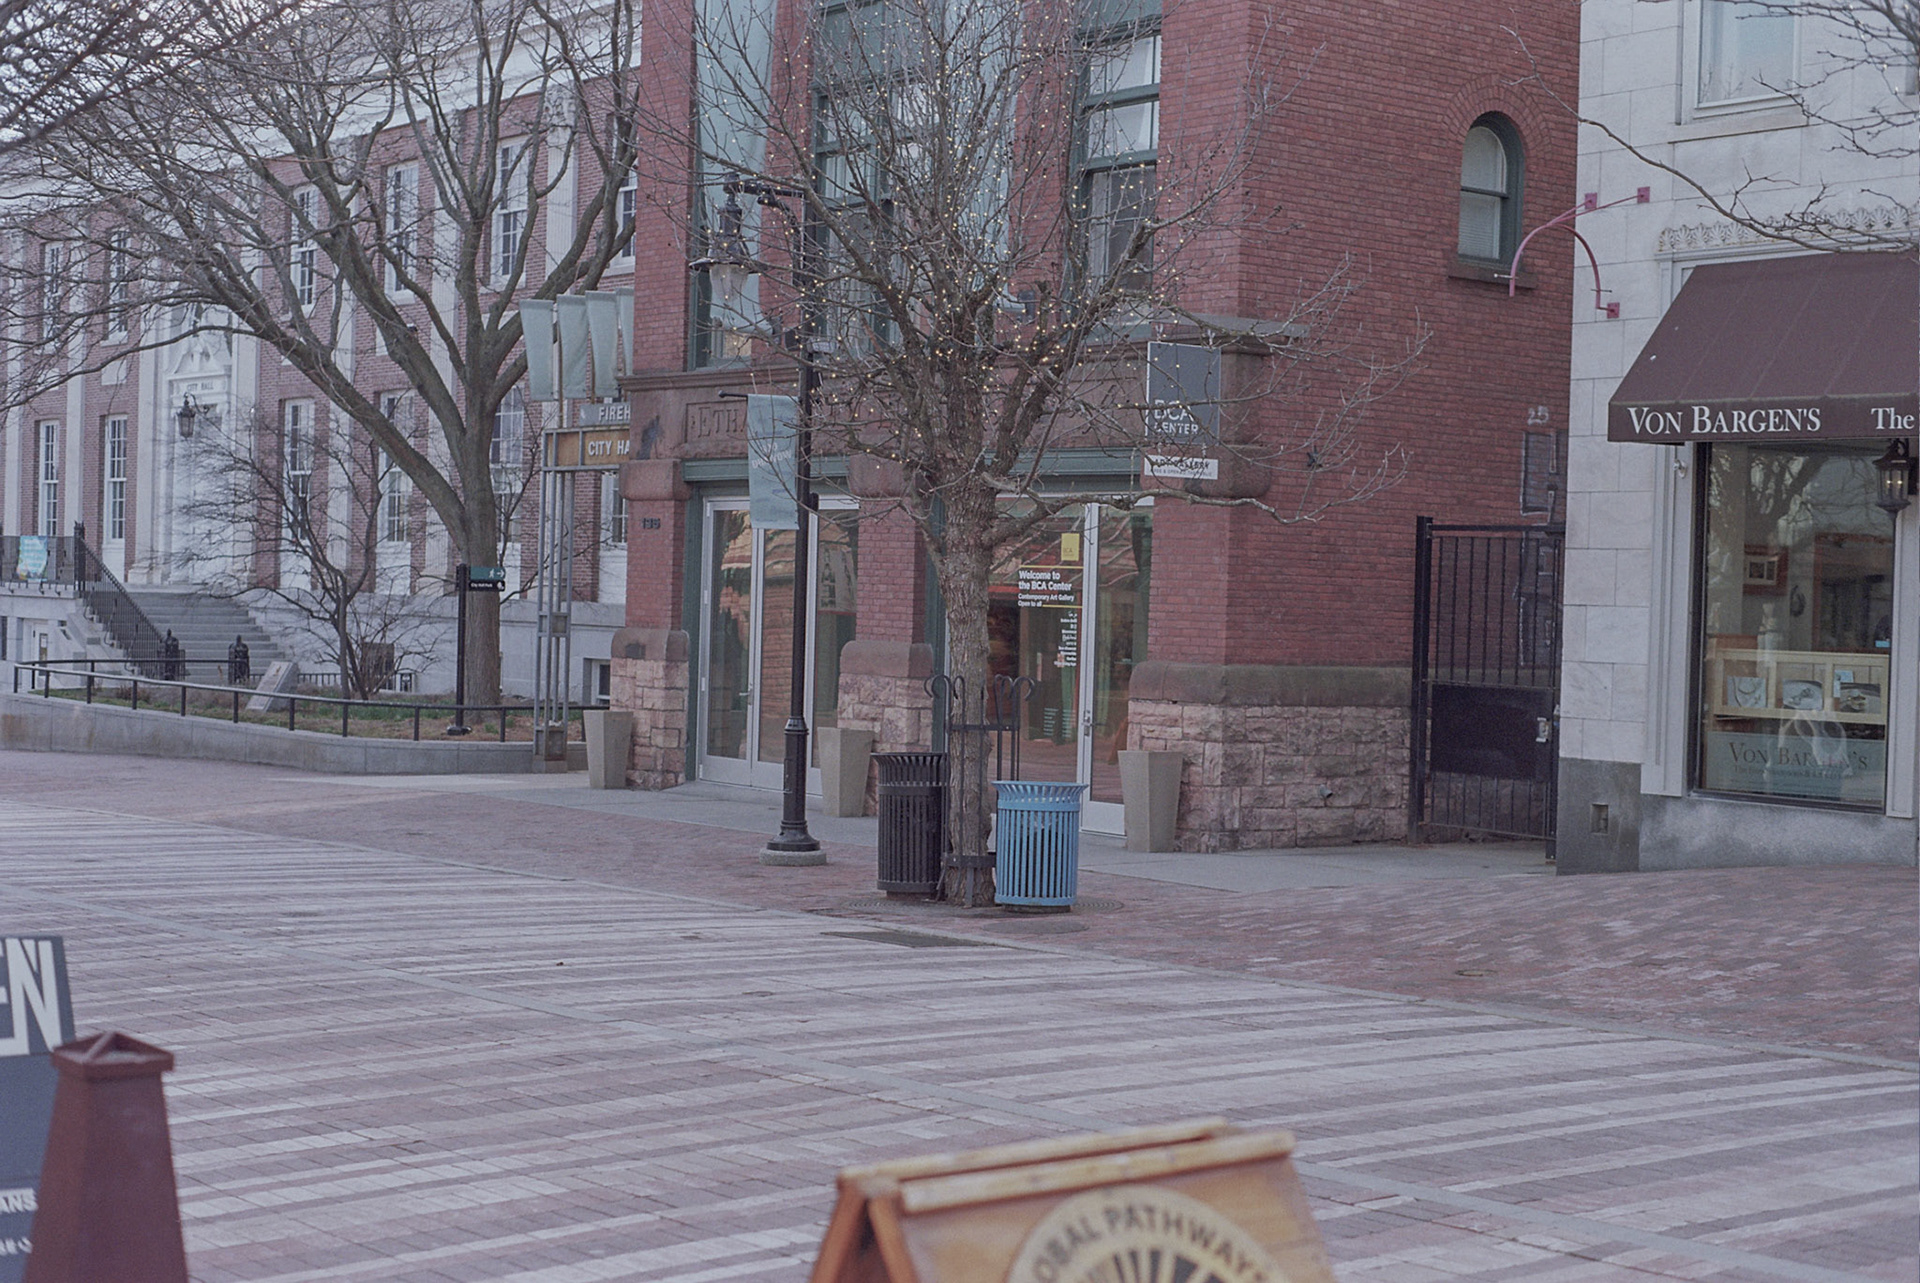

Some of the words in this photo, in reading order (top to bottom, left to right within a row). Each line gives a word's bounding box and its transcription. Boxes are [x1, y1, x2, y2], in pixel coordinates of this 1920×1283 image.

[1154, 399, 1194, 421] BCA
[1628, 407, 1683, 434] VON
[1690, 405, 1821, 434] BARGEN'S
[1871, 407, 1915, 430] The
[588, 440, 612, 456] CITY
[1018, 570, 1051, 579] Welcome
[1052, 571, 1061, 580] to
[1018, 581, 1030, 590] the
[1031, 581, 1047, 590] BCA
[1048, 581, 1072, 591] Center
[1018, 593, 1049, 601] Contemporary
[1058, 594, 1075, 602] Gallery
